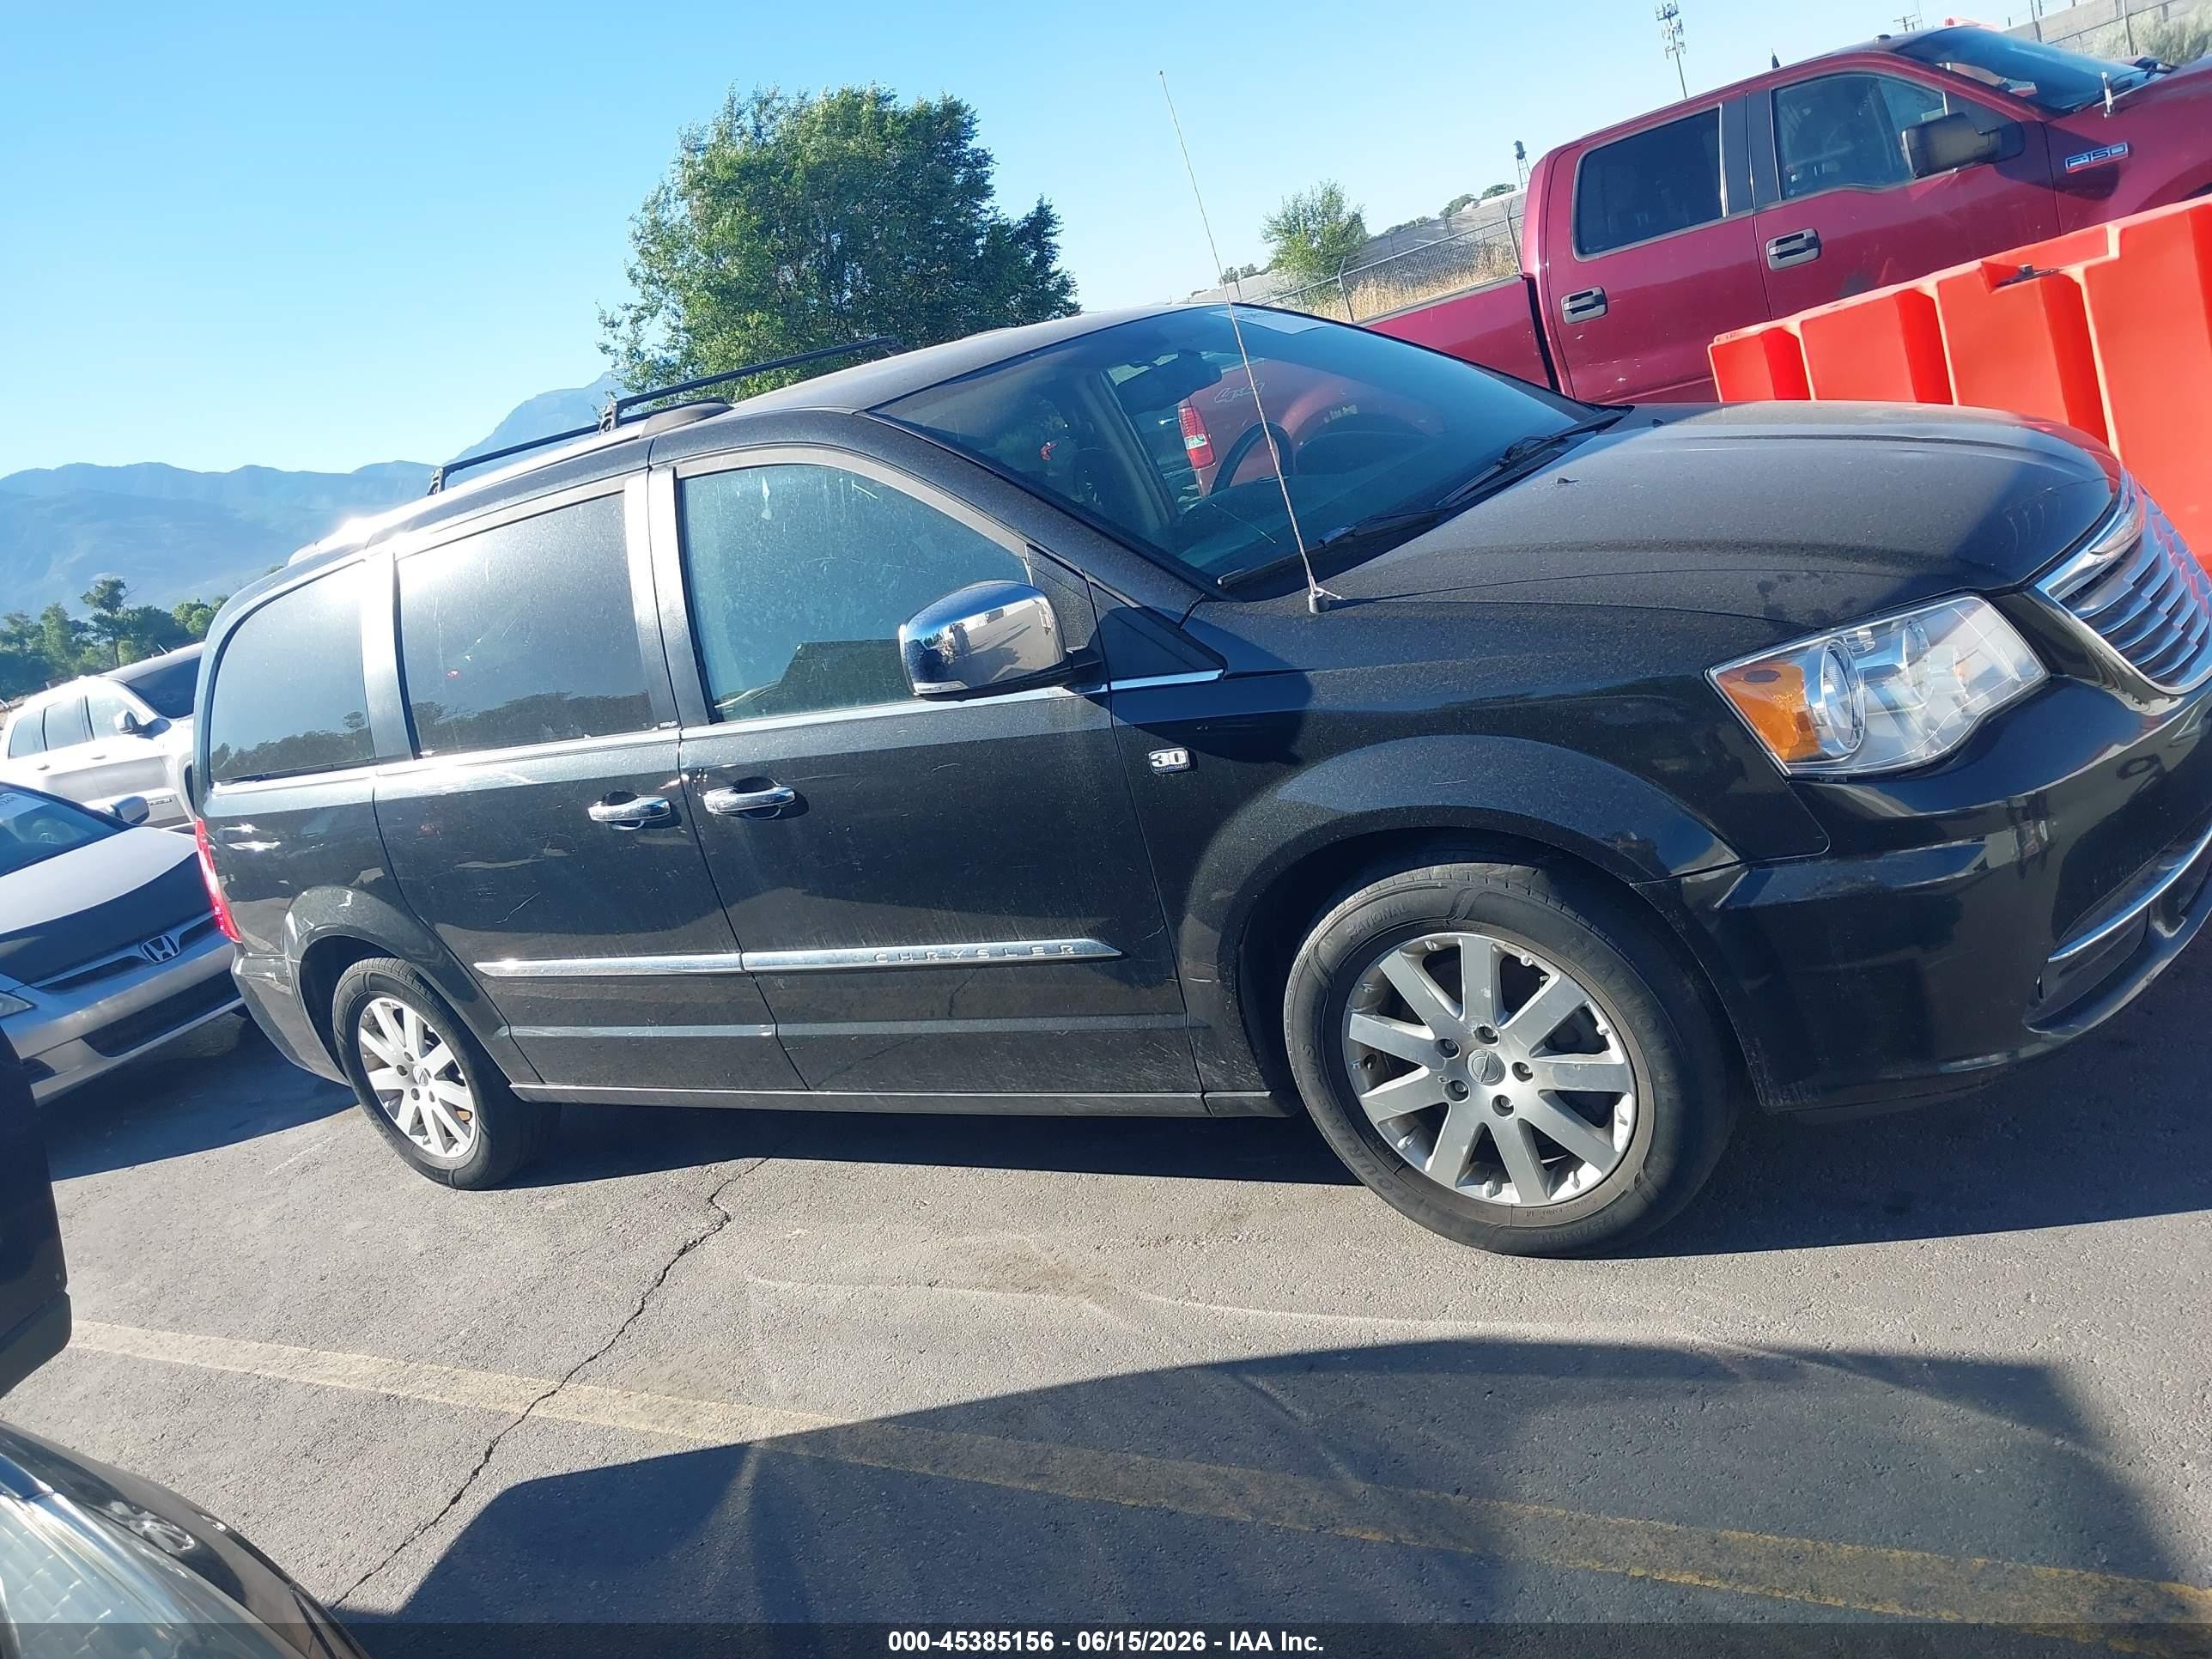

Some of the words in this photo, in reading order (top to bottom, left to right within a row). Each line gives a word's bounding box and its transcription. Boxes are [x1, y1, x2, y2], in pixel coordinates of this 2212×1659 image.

[2065, 143, 2129, 171] F-150
[1151, 750, 1187, 768] 30
[874, 945, 1075, 963] CHRYSLER
